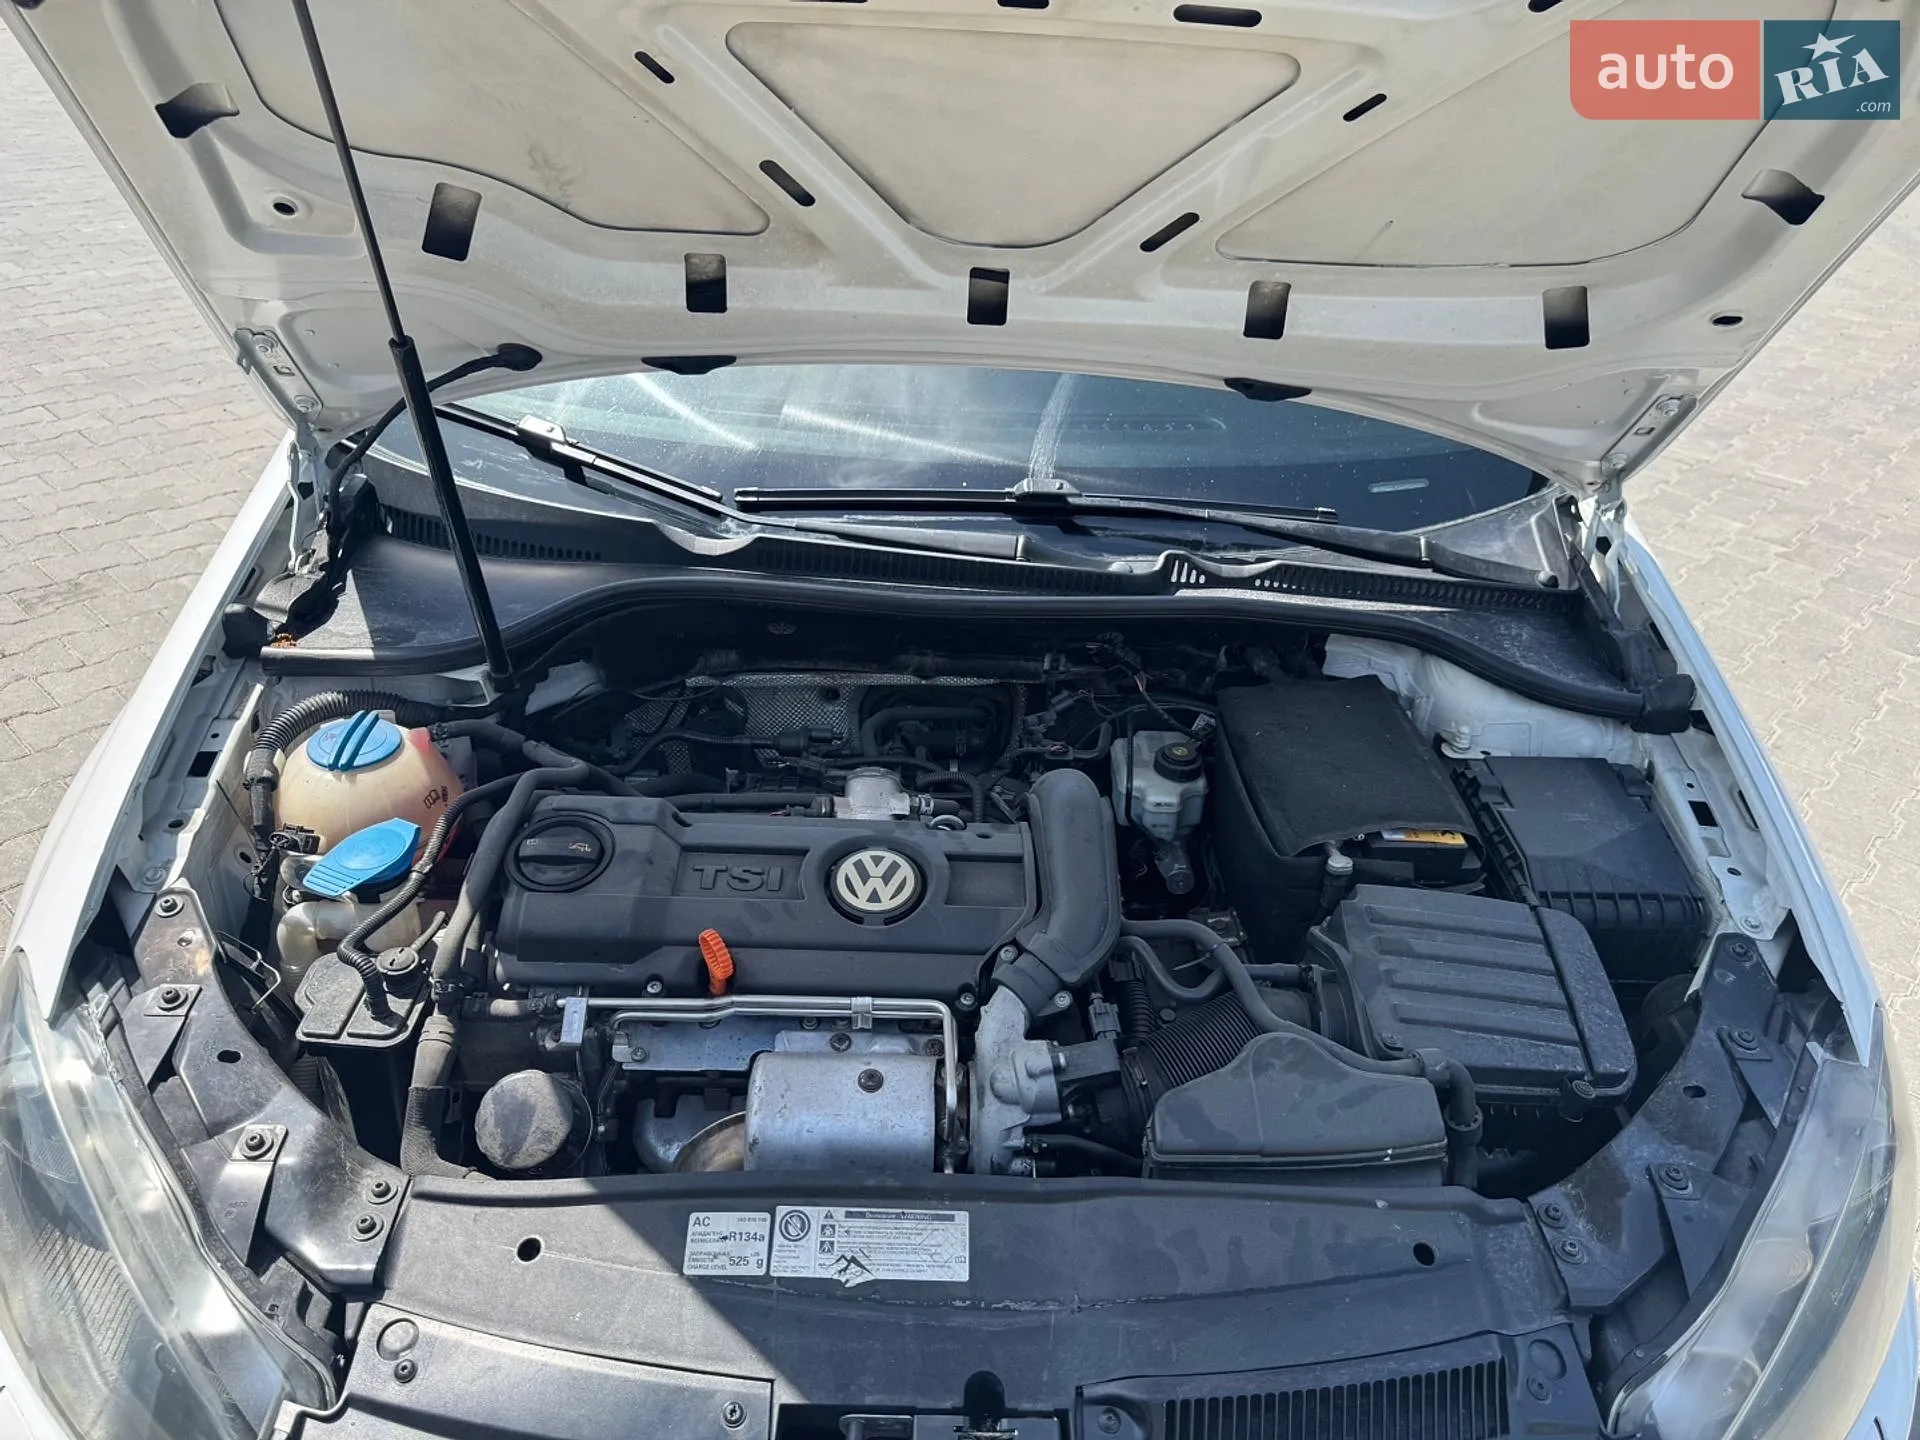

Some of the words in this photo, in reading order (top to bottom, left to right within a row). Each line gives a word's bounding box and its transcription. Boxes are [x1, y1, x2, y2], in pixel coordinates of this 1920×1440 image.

[693, 864, 785, 893] TSI
[692, 1216, 711, 1227] AC
[729, 1231, 765, 1242] R134a
[729, 1256, 750, 1267] 525
[756, 1258, 764, 1269] g
